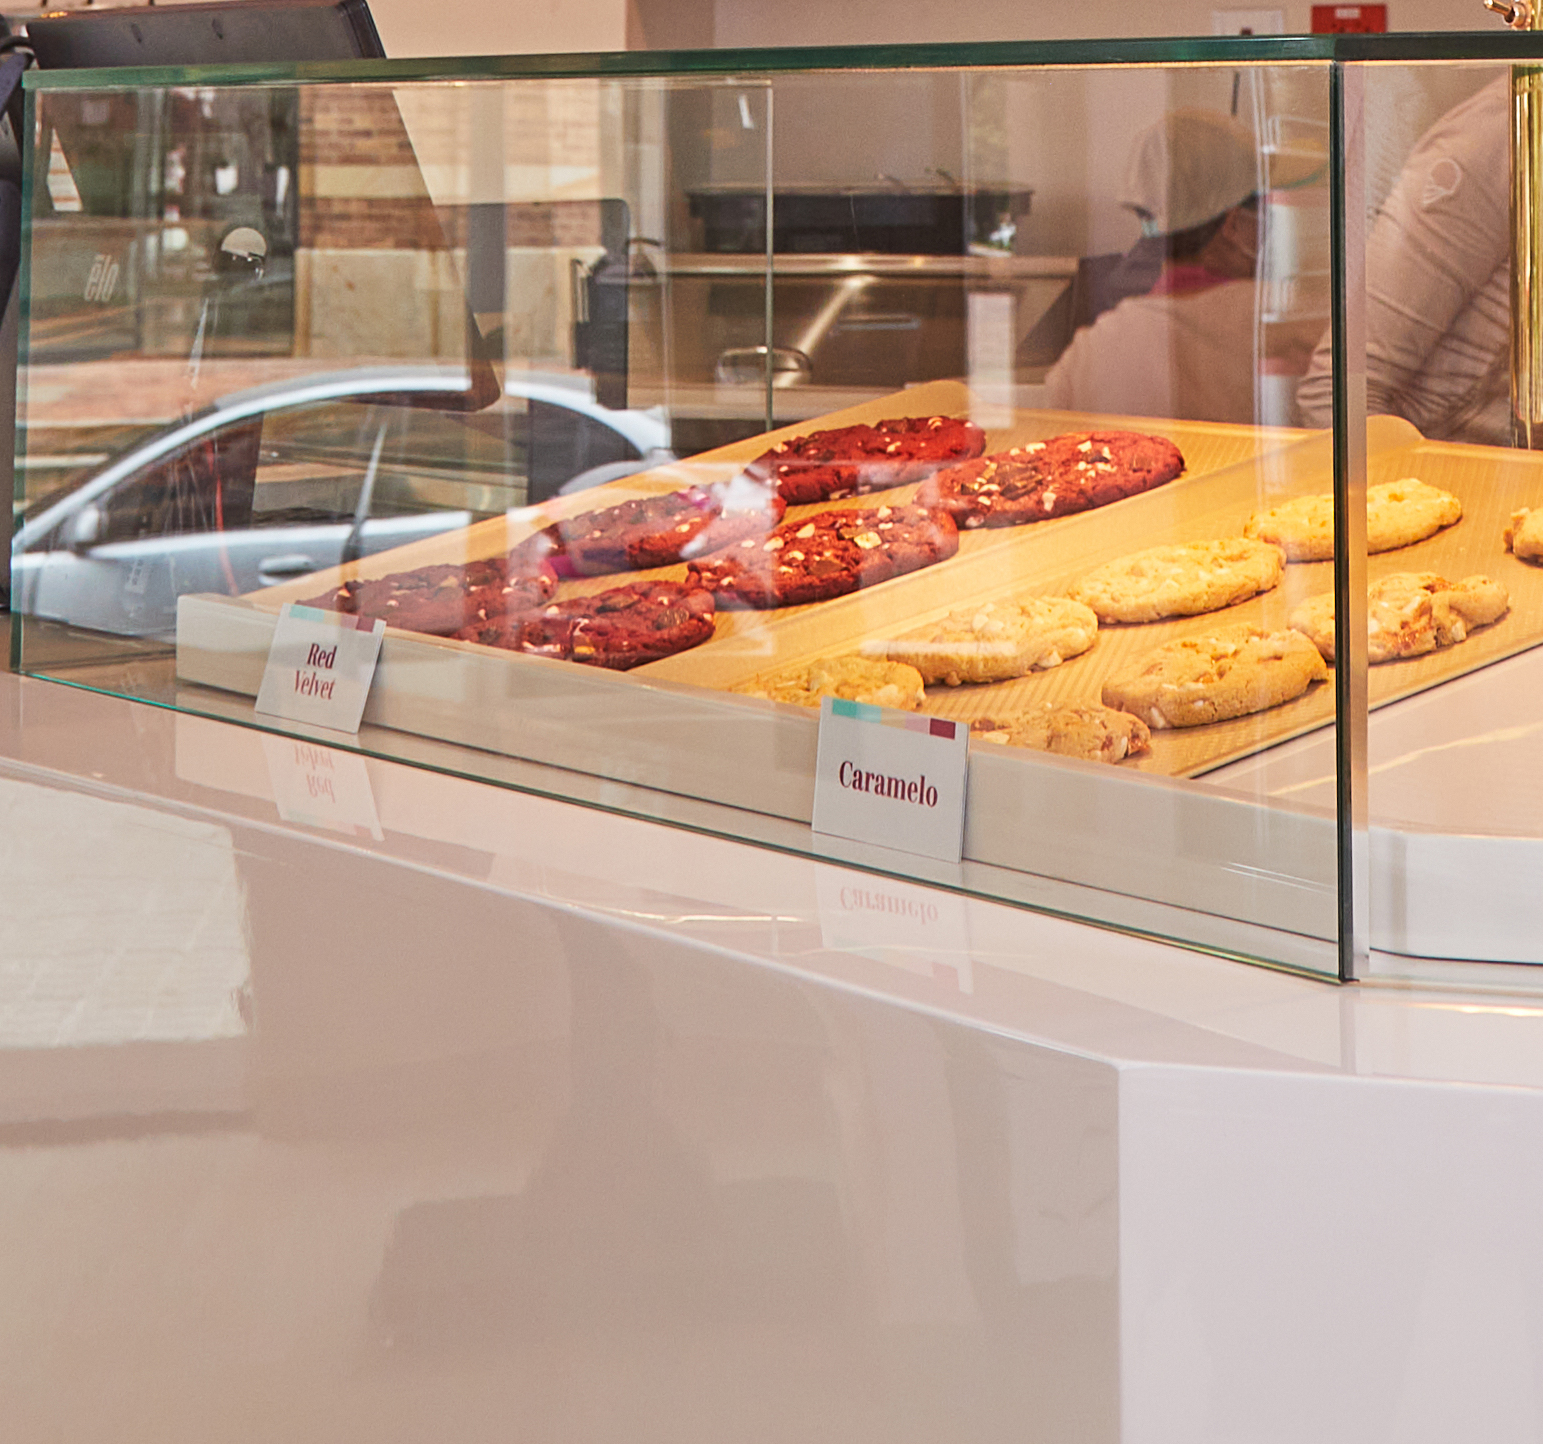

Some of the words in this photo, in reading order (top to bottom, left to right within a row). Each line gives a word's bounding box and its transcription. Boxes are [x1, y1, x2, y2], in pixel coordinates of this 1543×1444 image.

[307, 643, 338, 669] Red
[295, 670, 336, 700] Velvet
[839, 760, 939, 807] Caramelo
